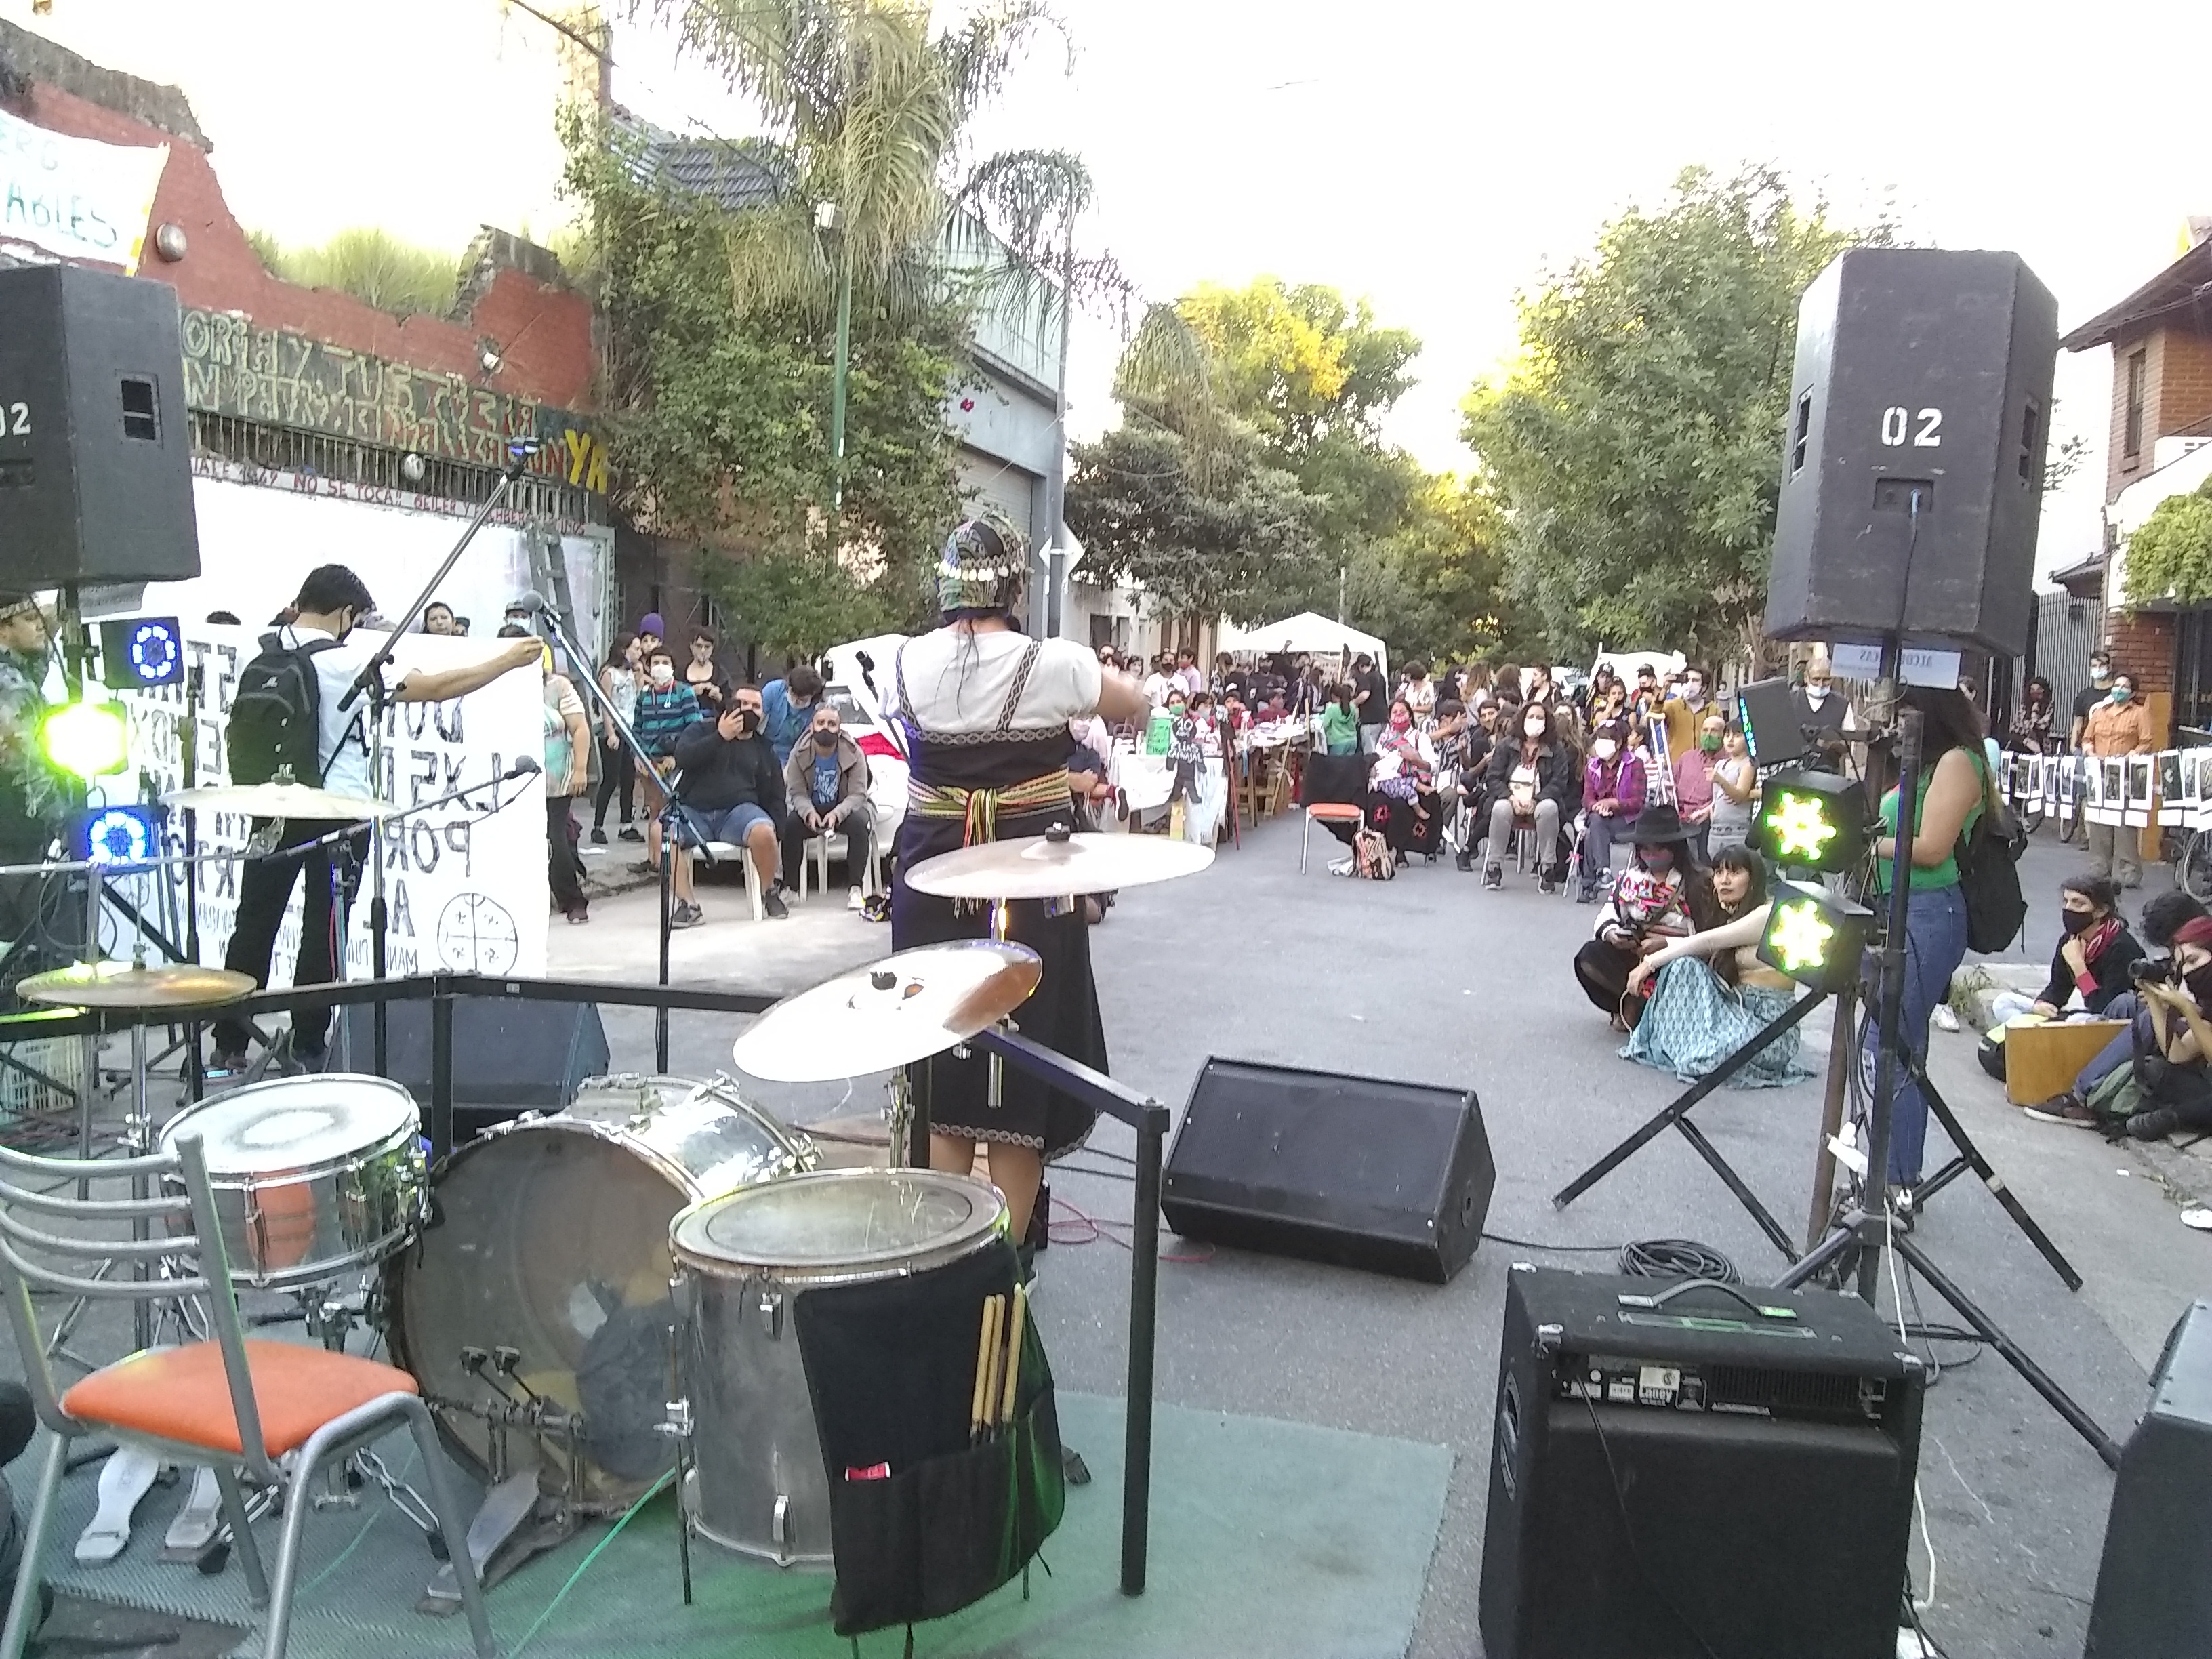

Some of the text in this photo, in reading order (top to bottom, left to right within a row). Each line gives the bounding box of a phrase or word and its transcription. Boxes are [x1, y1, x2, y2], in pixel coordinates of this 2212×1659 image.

[1881, 405, 1943, 447] 02
[293, 472, 318, 495] NO
[328, 479, 348, 499] SE
[1177, 718, 1193, 731] 10
